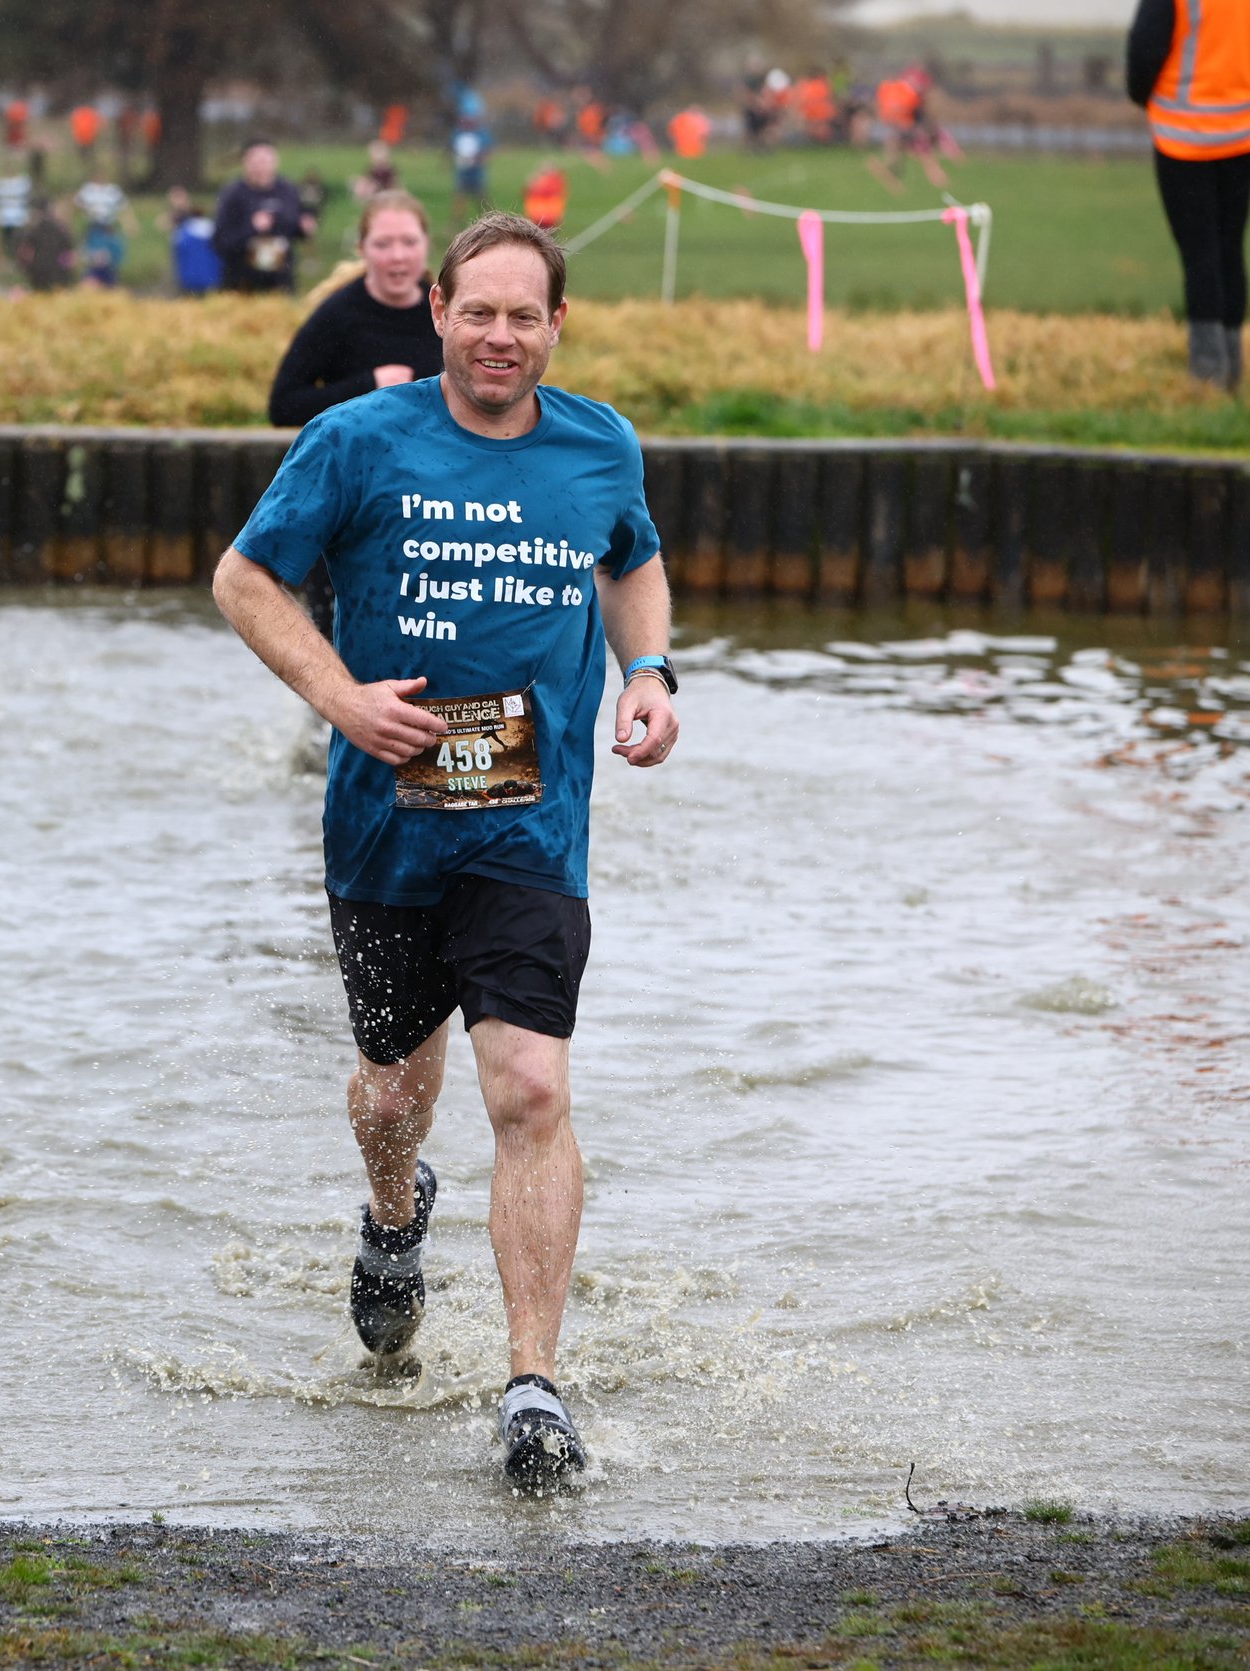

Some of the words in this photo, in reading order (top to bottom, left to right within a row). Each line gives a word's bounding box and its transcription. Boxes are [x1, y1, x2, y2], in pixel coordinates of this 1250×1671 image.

[401, 494, 454, 519] I'm
[465, 500, 523, 523] not
[402, 537, 594, 570] competitive
[400, 573, 410, 597] I
[414, 572, 483, 604] just
[494, 575, 555, 606] like
[561, 584, 583, 606] to
[397, 611, 457, 641] win
[434, 707, 501, 724] ALLENGE
[444, 703, 462, 713] GUY
[462, 701, 481, 711] AND
[481, 700, 500, 709] GAL
[456, 726, 481, 735] ULTIMATE
[493, 723, 505, 731] RUN
[436, 738, 493, 773] 458
[447, 775, 488, 792] STEVE
